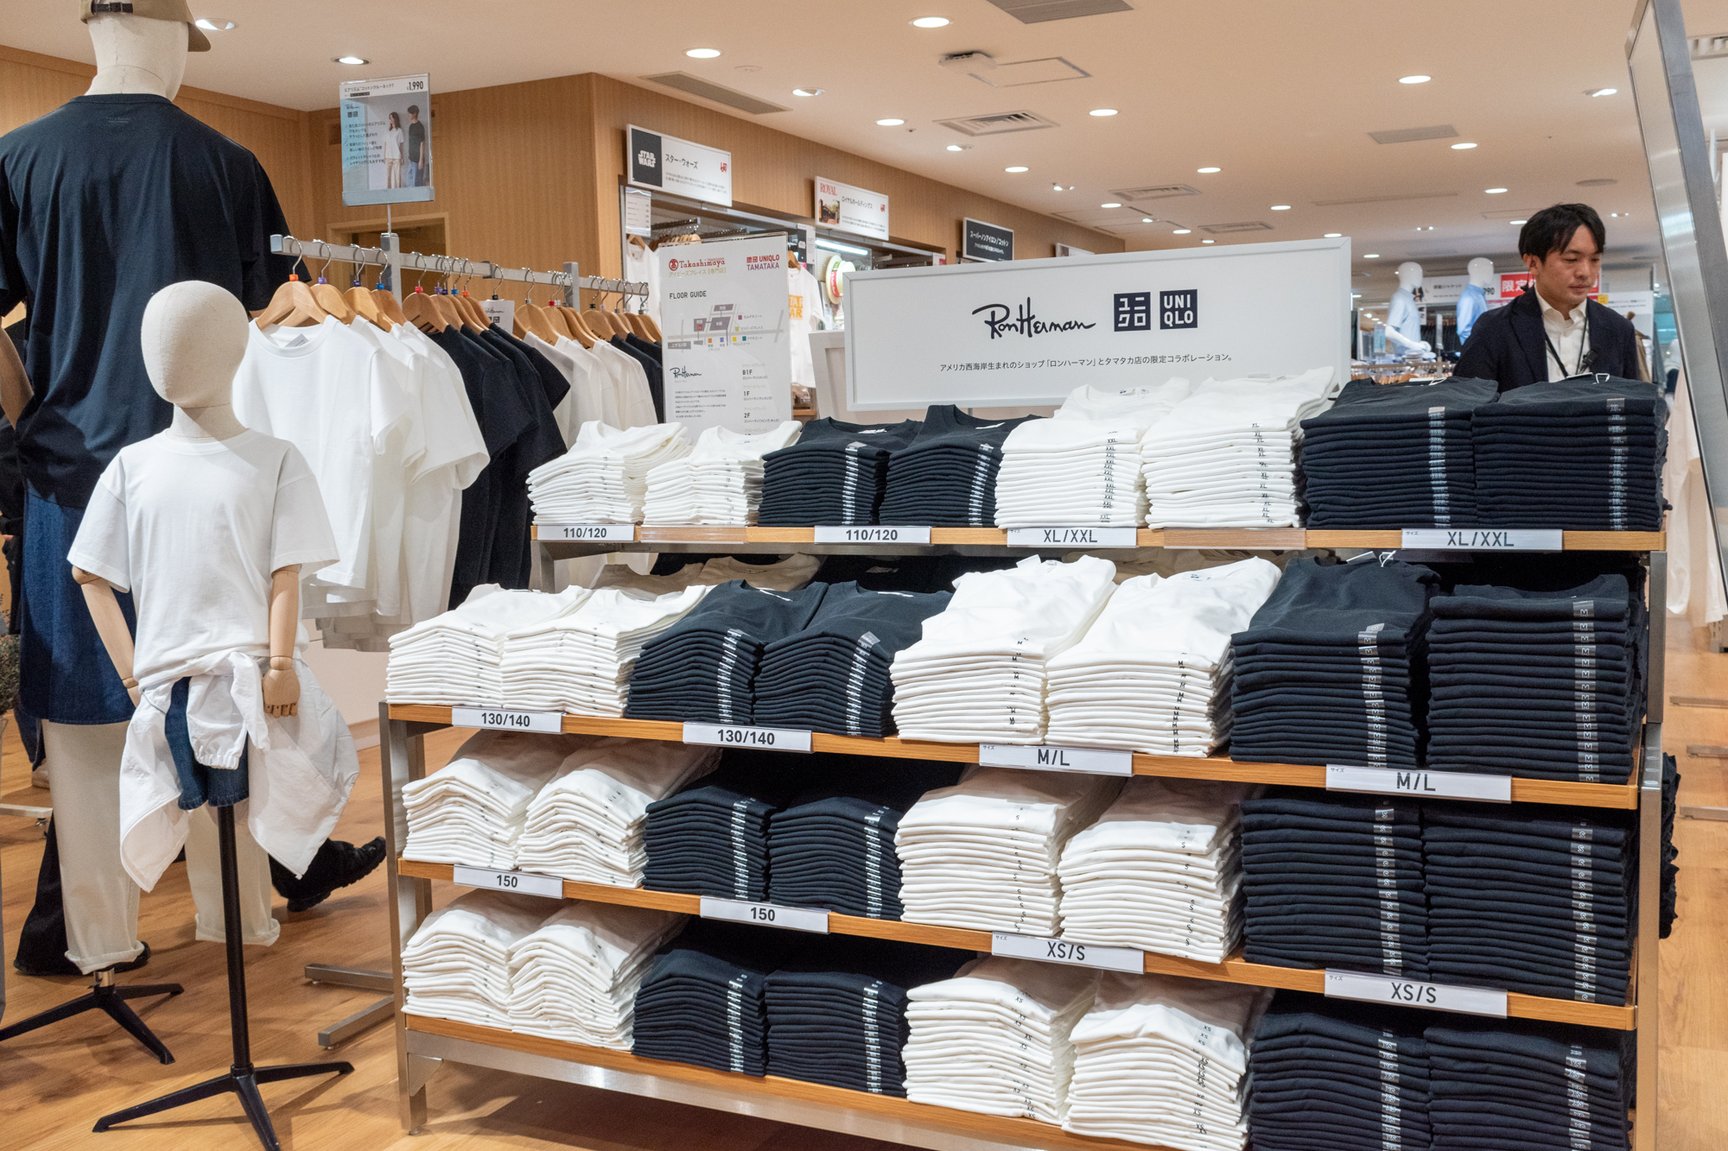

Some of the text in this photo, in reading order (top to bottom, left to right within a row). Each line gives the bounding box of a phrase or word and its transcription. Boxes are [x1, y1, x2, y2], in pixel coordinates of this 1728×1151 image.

[747, 262, 780, 271] TAMATAKA
[563, 527, 607, 538] 110/120
[846, 529, 898, 541] 110/120
[1043, 529, 1098, 543] XL/XXL
[1447, 531, 1514, 546] XL/XXL
[481, 712, 530, 727] 130/140
[718, 728, 775, 746] 130/140
[1038, 748, 1070, 766] M/L
[1396, 772, 1436, 792] M/L
[496, 874, 518, 888] 150
[750, 906, 776, 922] 150
[1046, 941, 1086, 961] XS/S
[1391, 982, 1437, 1004] XS/S
